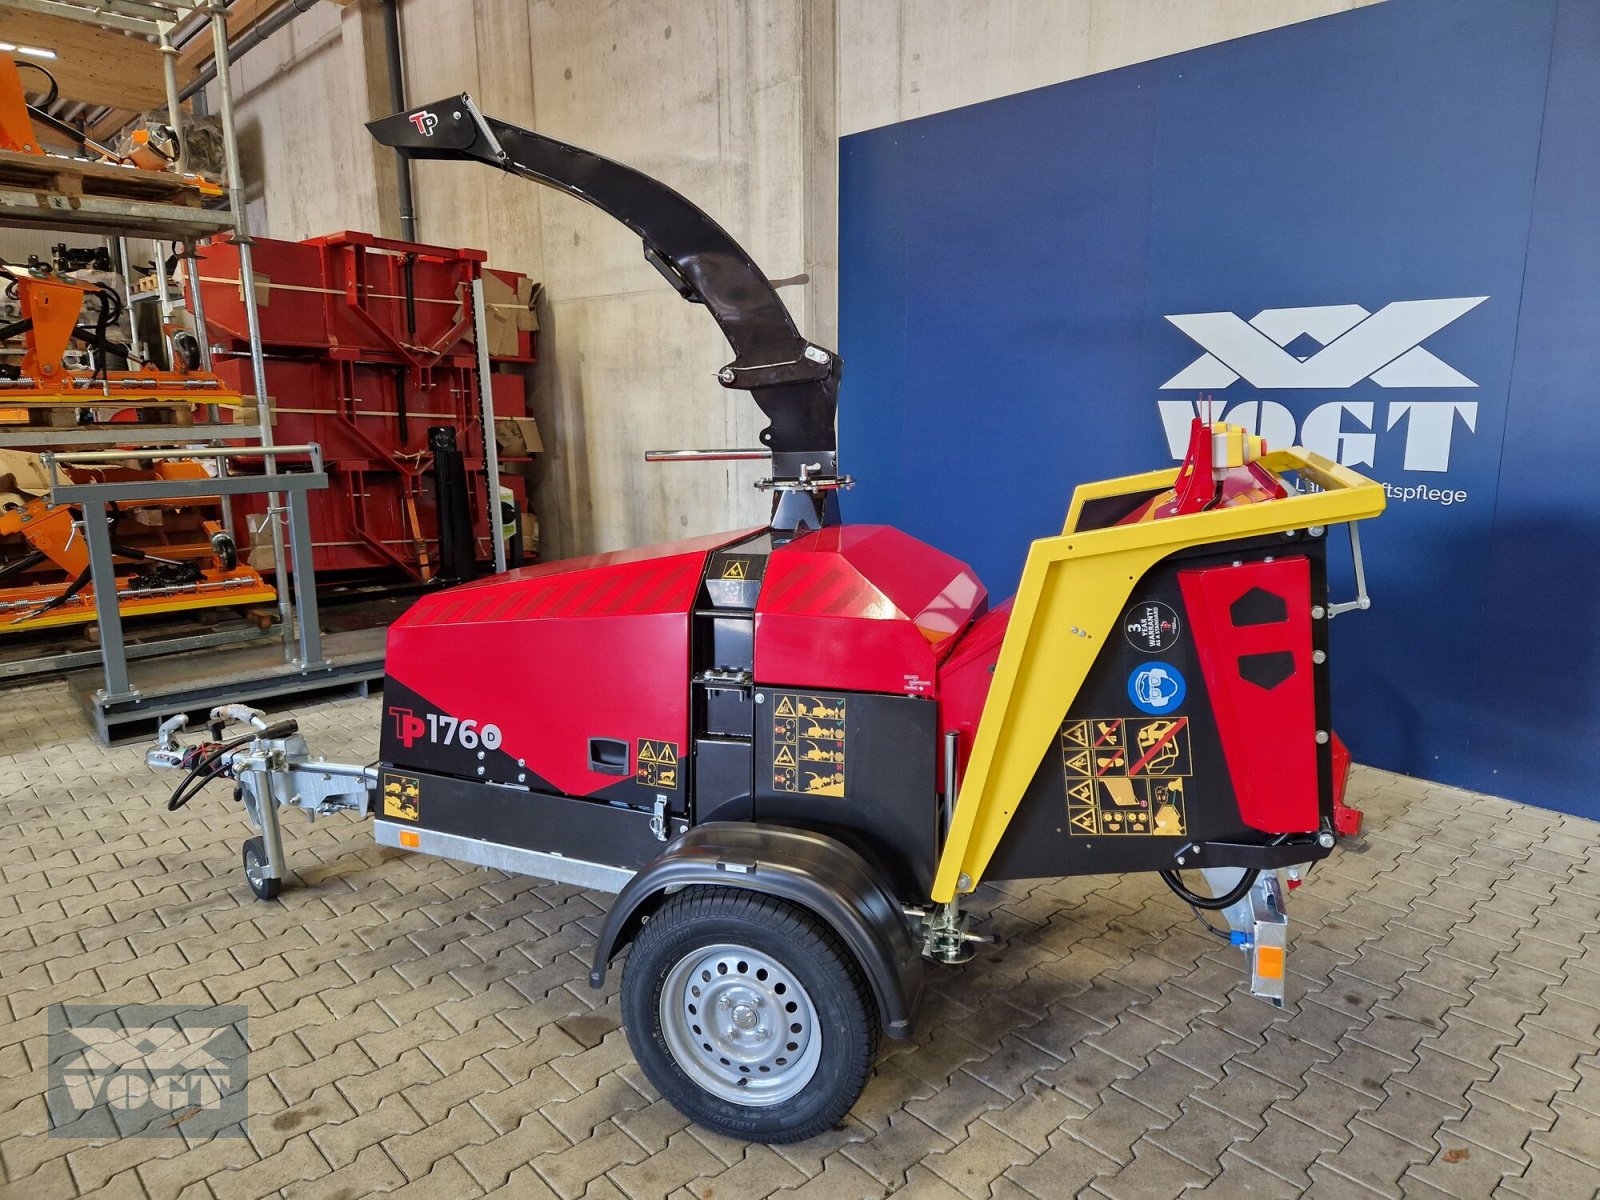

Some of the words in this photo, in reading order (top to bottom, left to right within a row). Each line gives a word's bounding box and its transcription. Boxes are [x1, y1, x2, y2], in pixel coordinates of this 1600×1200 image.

[409, 110, 438, 137] TP
[1127, 623, 1141, 632] 3
[1146, 607, 1156, 647] WARRANTY
